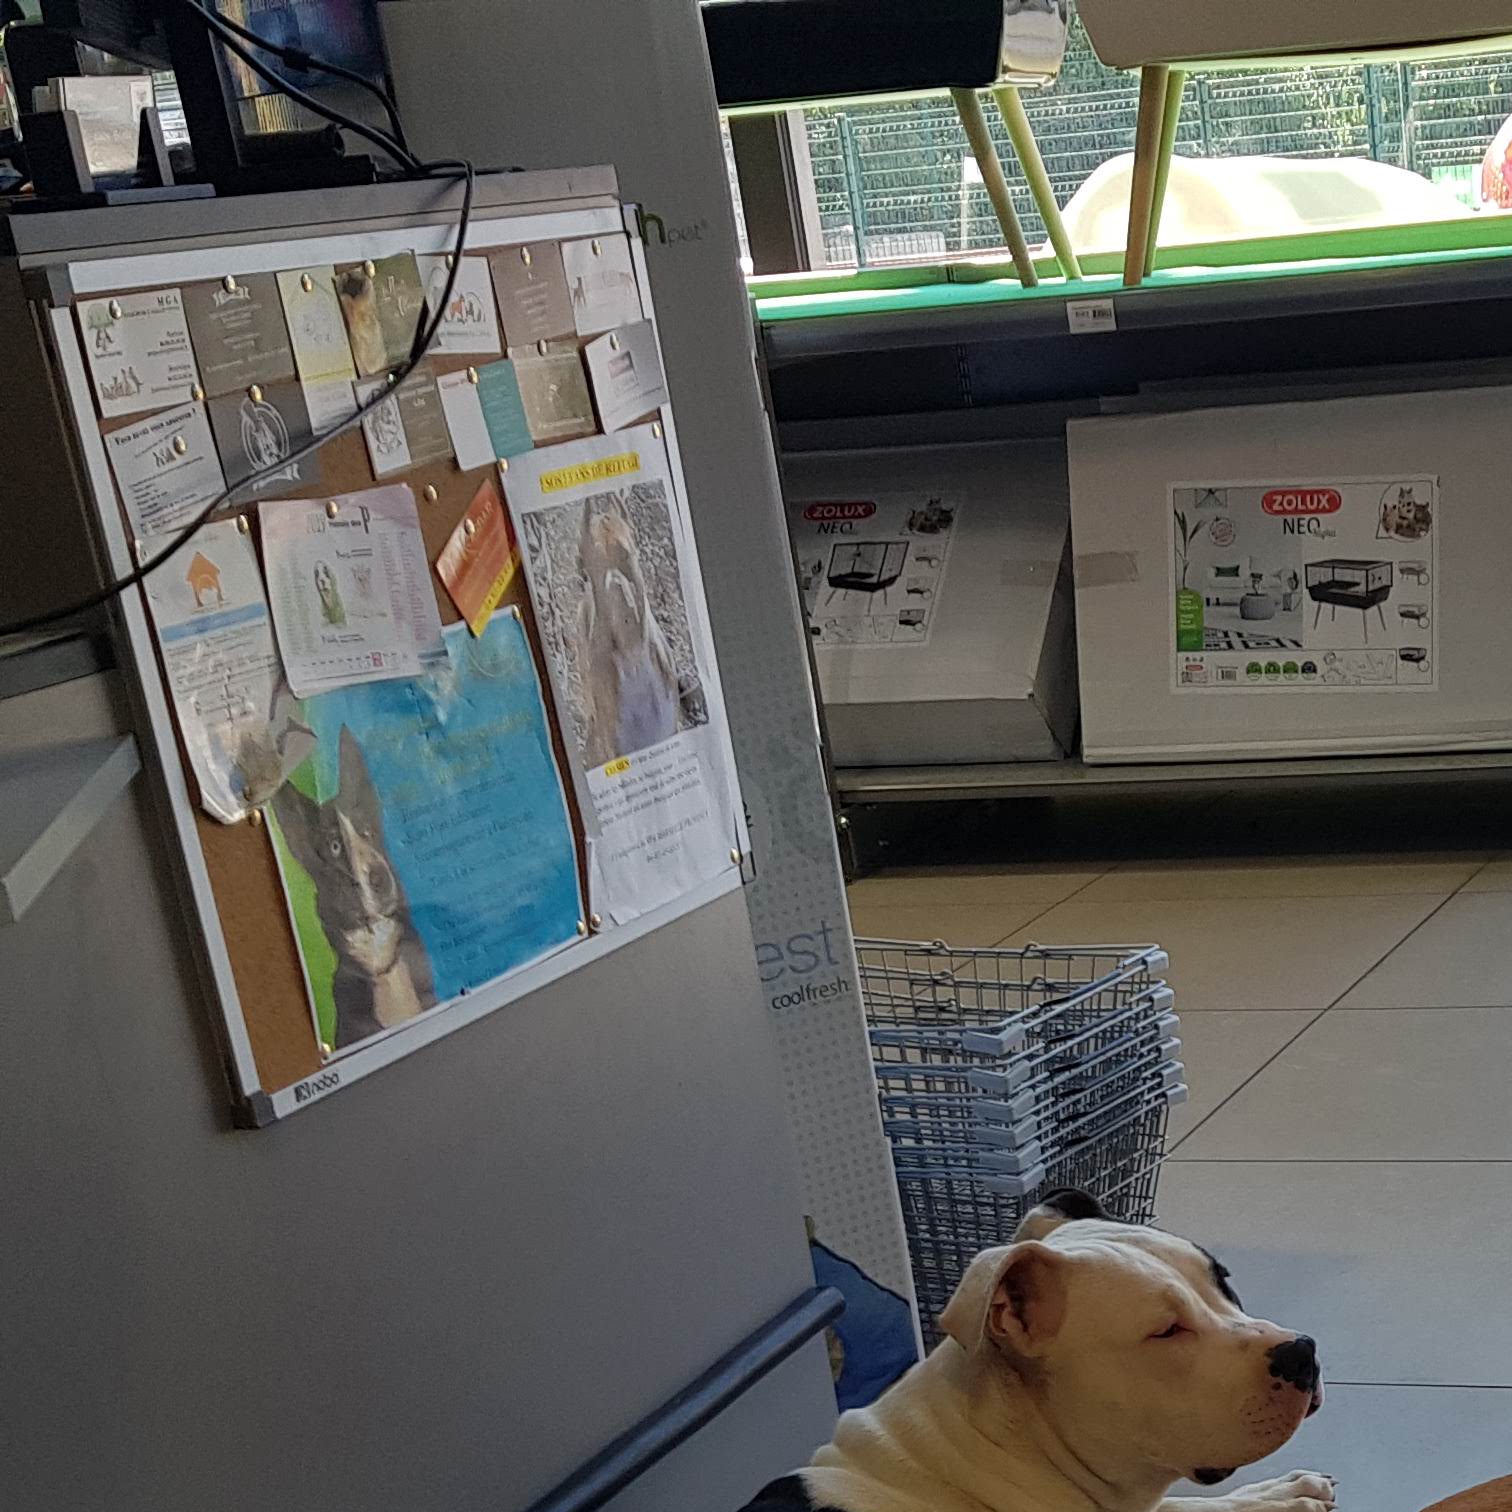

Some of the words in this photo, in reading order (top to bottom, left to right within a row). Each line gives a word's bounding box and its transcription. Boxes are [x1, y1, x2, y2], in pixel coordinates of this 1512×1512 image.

[1271, 493, 1332, 511] ZOLUX
[813, 505, 867, 519] ZOLUX
[817, 521, 852, 535] NEO
[1283, 516, 1321, 535] NEO
[771, 976, 850, 1010] coolfresh
